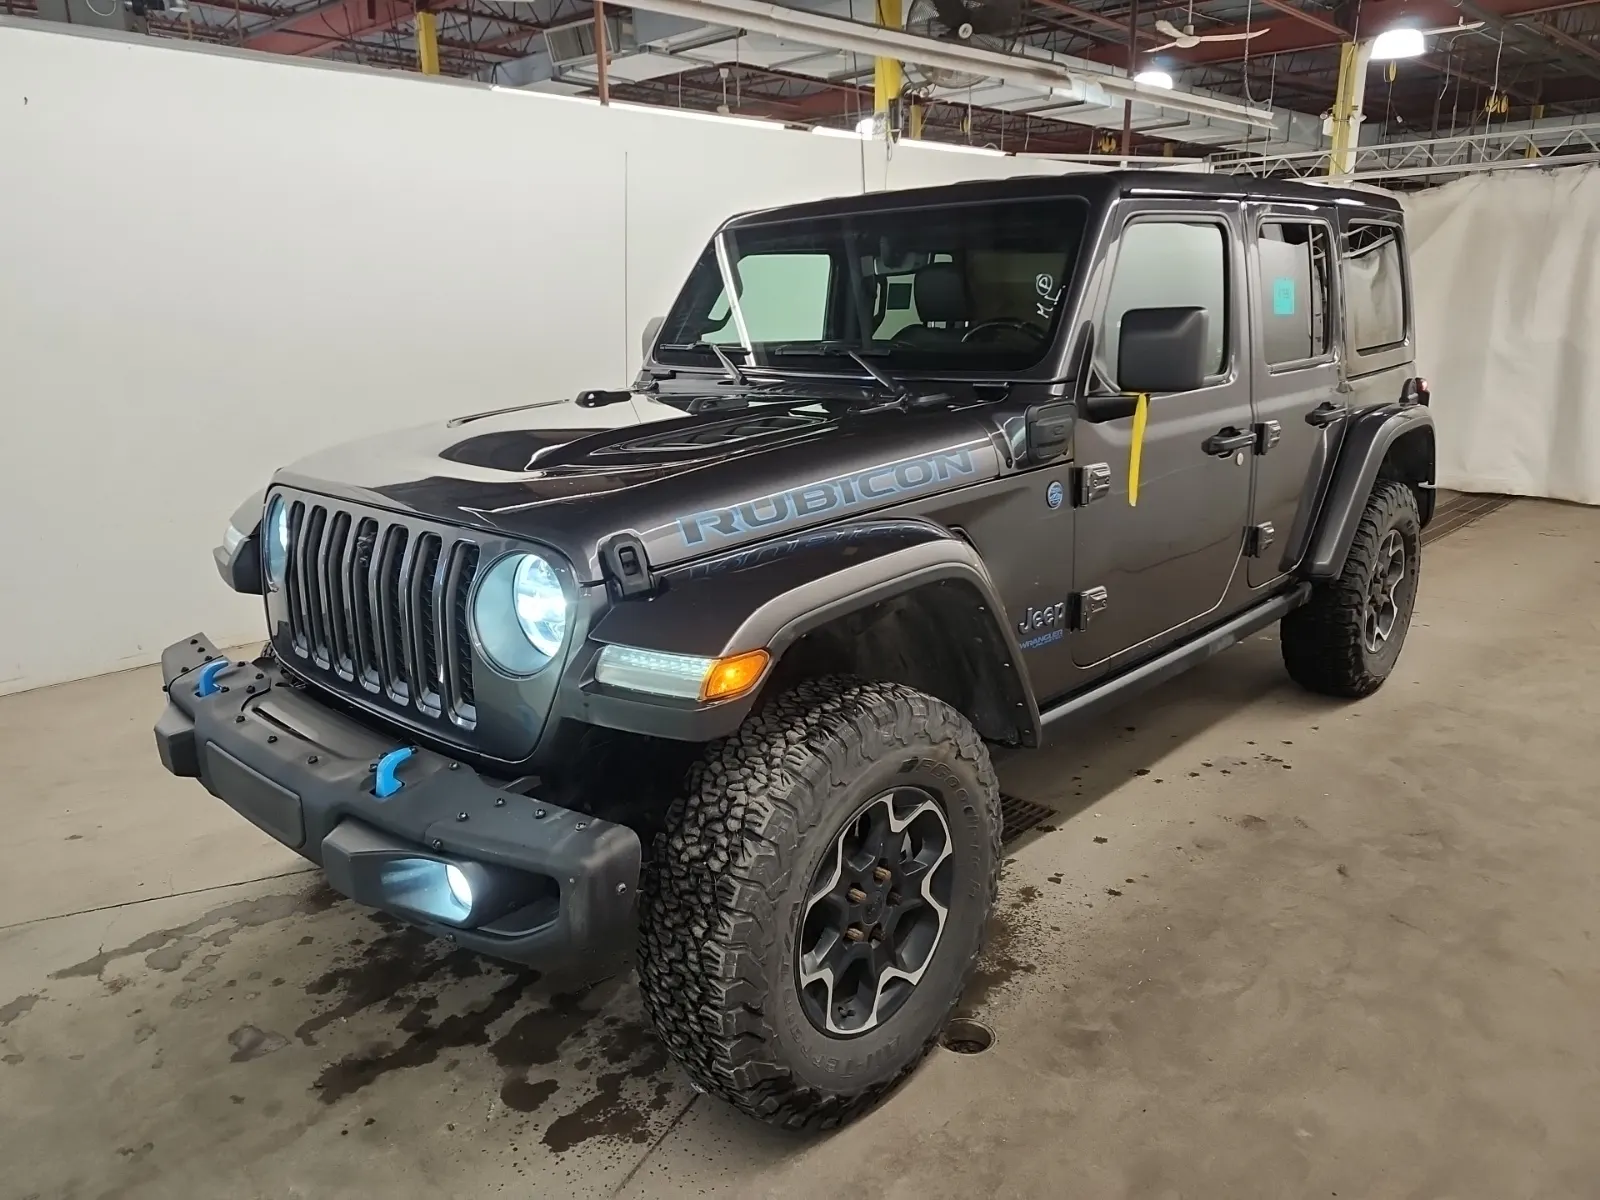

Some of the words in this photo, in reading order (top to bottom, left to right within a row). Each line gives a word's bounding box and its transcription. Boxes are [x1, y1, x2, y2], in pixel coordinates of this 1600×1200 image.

[677, 450, 976, 546] RUBICON
[1018, 602, 1065, 634] Jeep
[1019, 629, 1064, 649] WRANGLER
